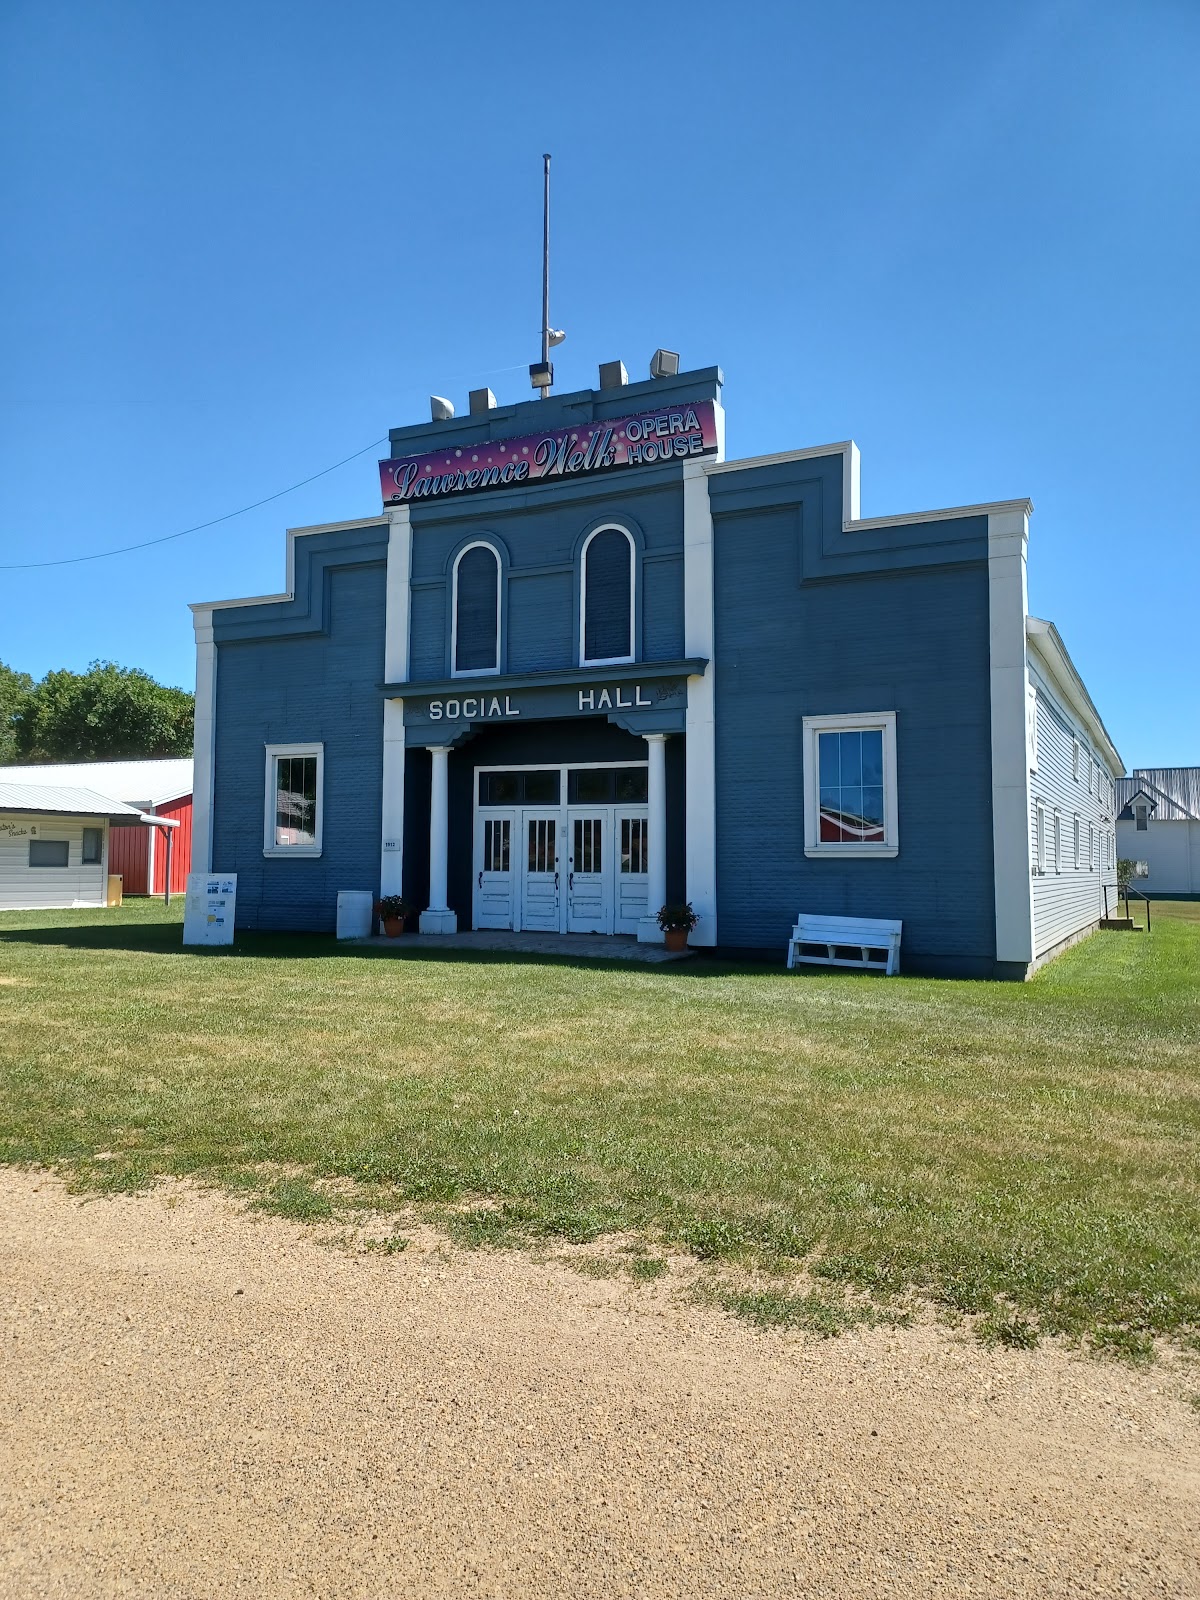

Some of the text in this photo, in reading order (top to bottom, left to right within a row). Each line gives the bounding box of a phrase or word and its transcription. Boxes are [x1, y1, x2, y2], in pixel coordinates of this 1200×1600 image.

[626, 410, 700, 442] OPERA
[391, 428, 616, 500] Lawrence Welk
[627, 434, 703, 465] HOUSE
[429, 696, 520, 720] SOCIAL
[578, 686, 651, 710] HALL
